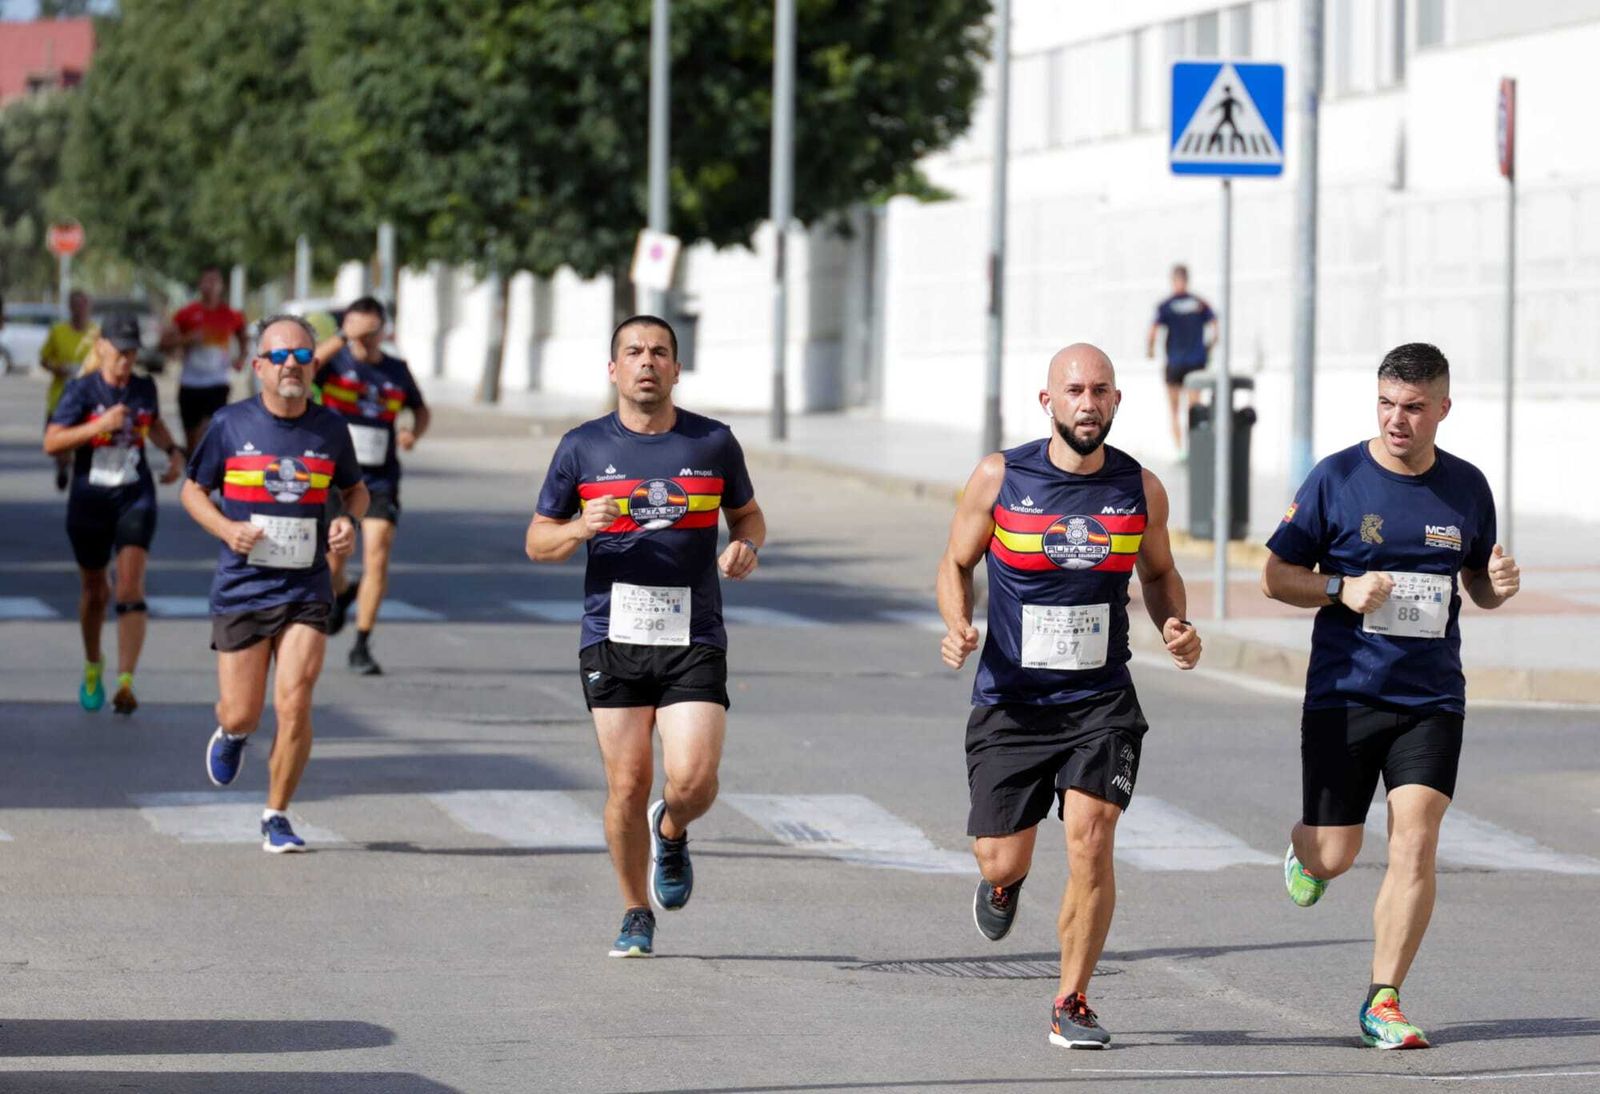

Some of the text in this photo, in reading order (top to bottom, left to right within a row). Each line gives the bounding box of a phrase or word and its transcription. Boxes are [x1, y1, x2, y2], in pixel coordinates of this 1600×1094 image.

[596, 474, 627, 482] Santander
[1010, 503, 1044, 514] Santander
[1046, 546, 1081, 554] RUTA
[1398, 606, 1420, 622] 88
[633, 618, 666, 632] 296
[1056, 640, 1080, 656] 97
[1111, 774, 1132, 796] NIKE
